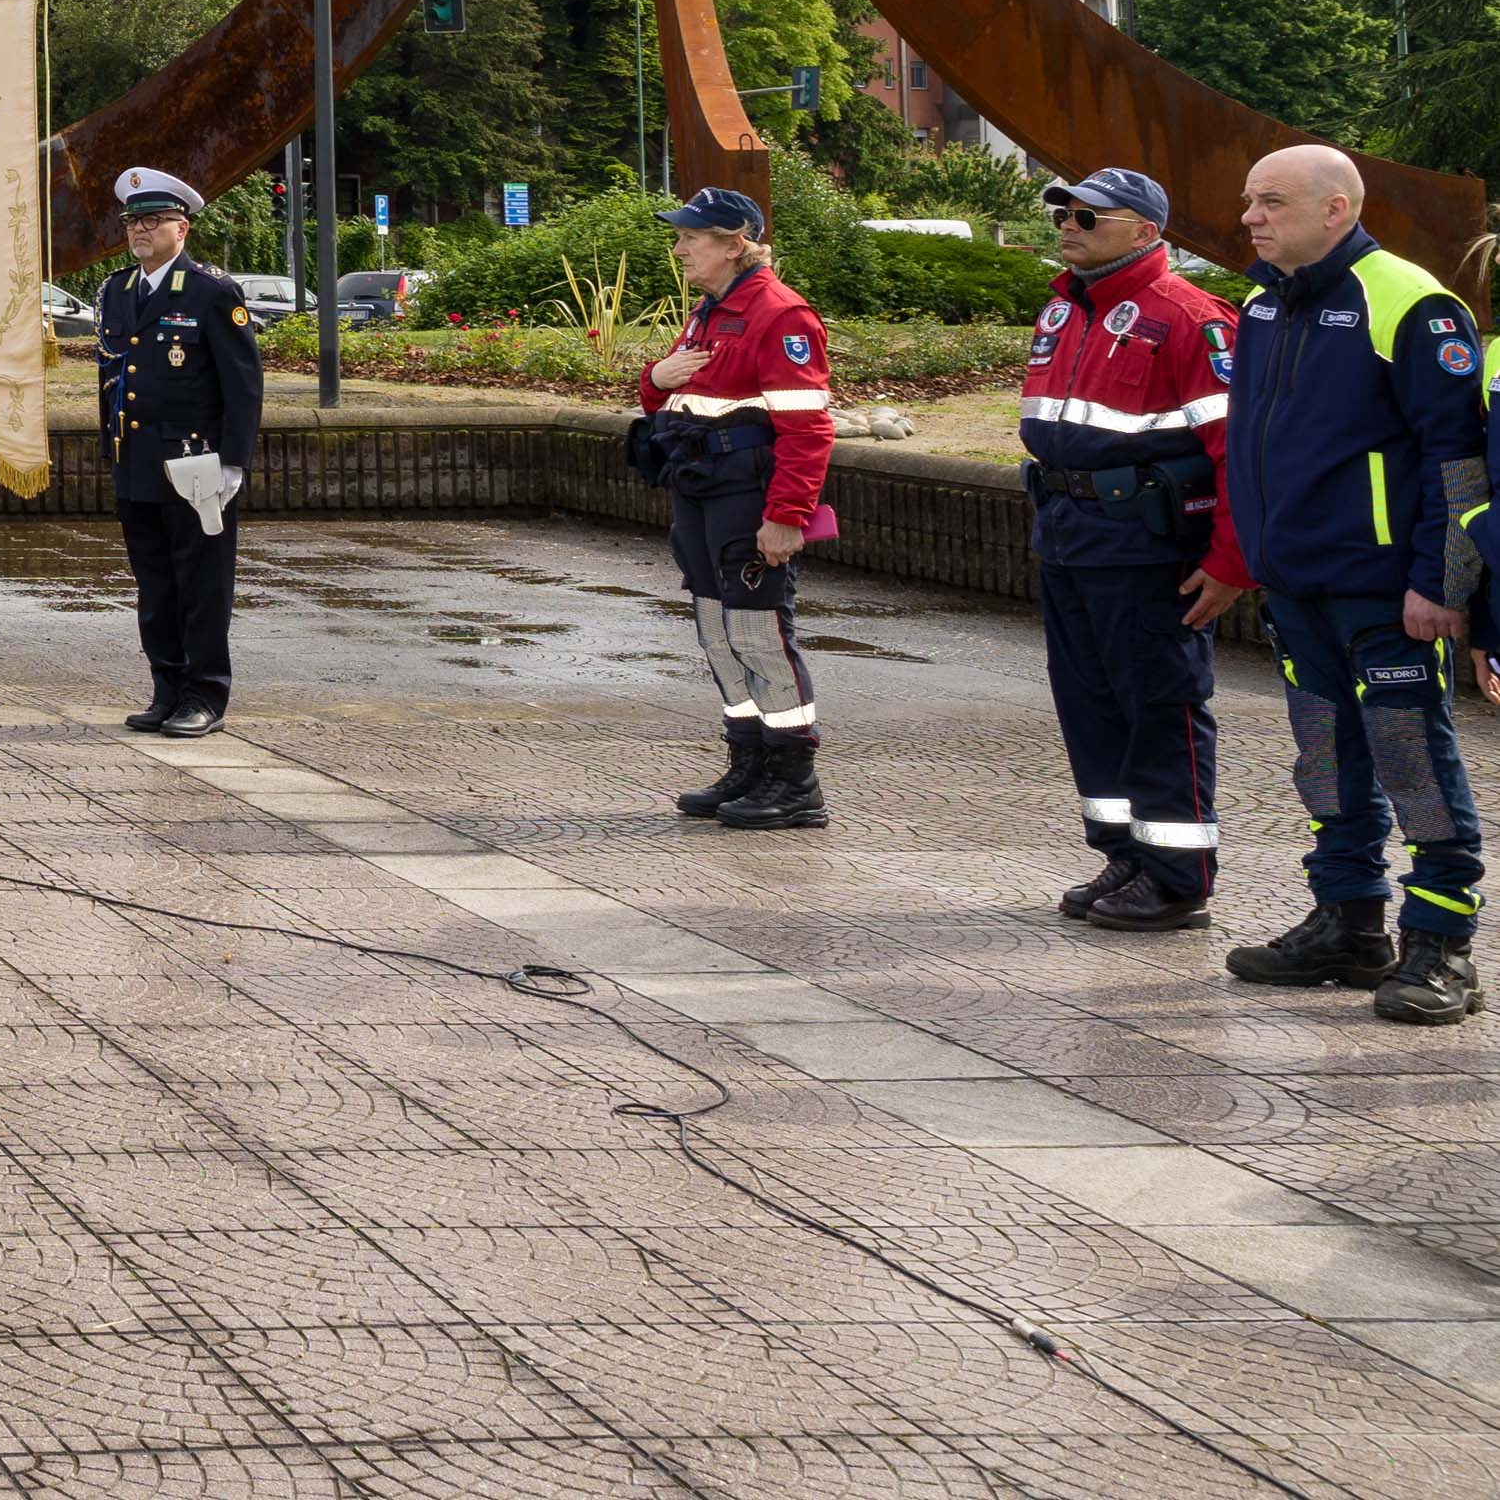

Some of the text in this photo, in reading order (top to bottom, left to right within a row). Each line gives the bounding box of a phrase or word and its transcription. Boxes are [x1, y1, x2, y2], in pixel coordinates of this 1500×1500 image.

[378, 197, 385, 212] P
[1375, 669, 1418, 679] SQ IDRO
